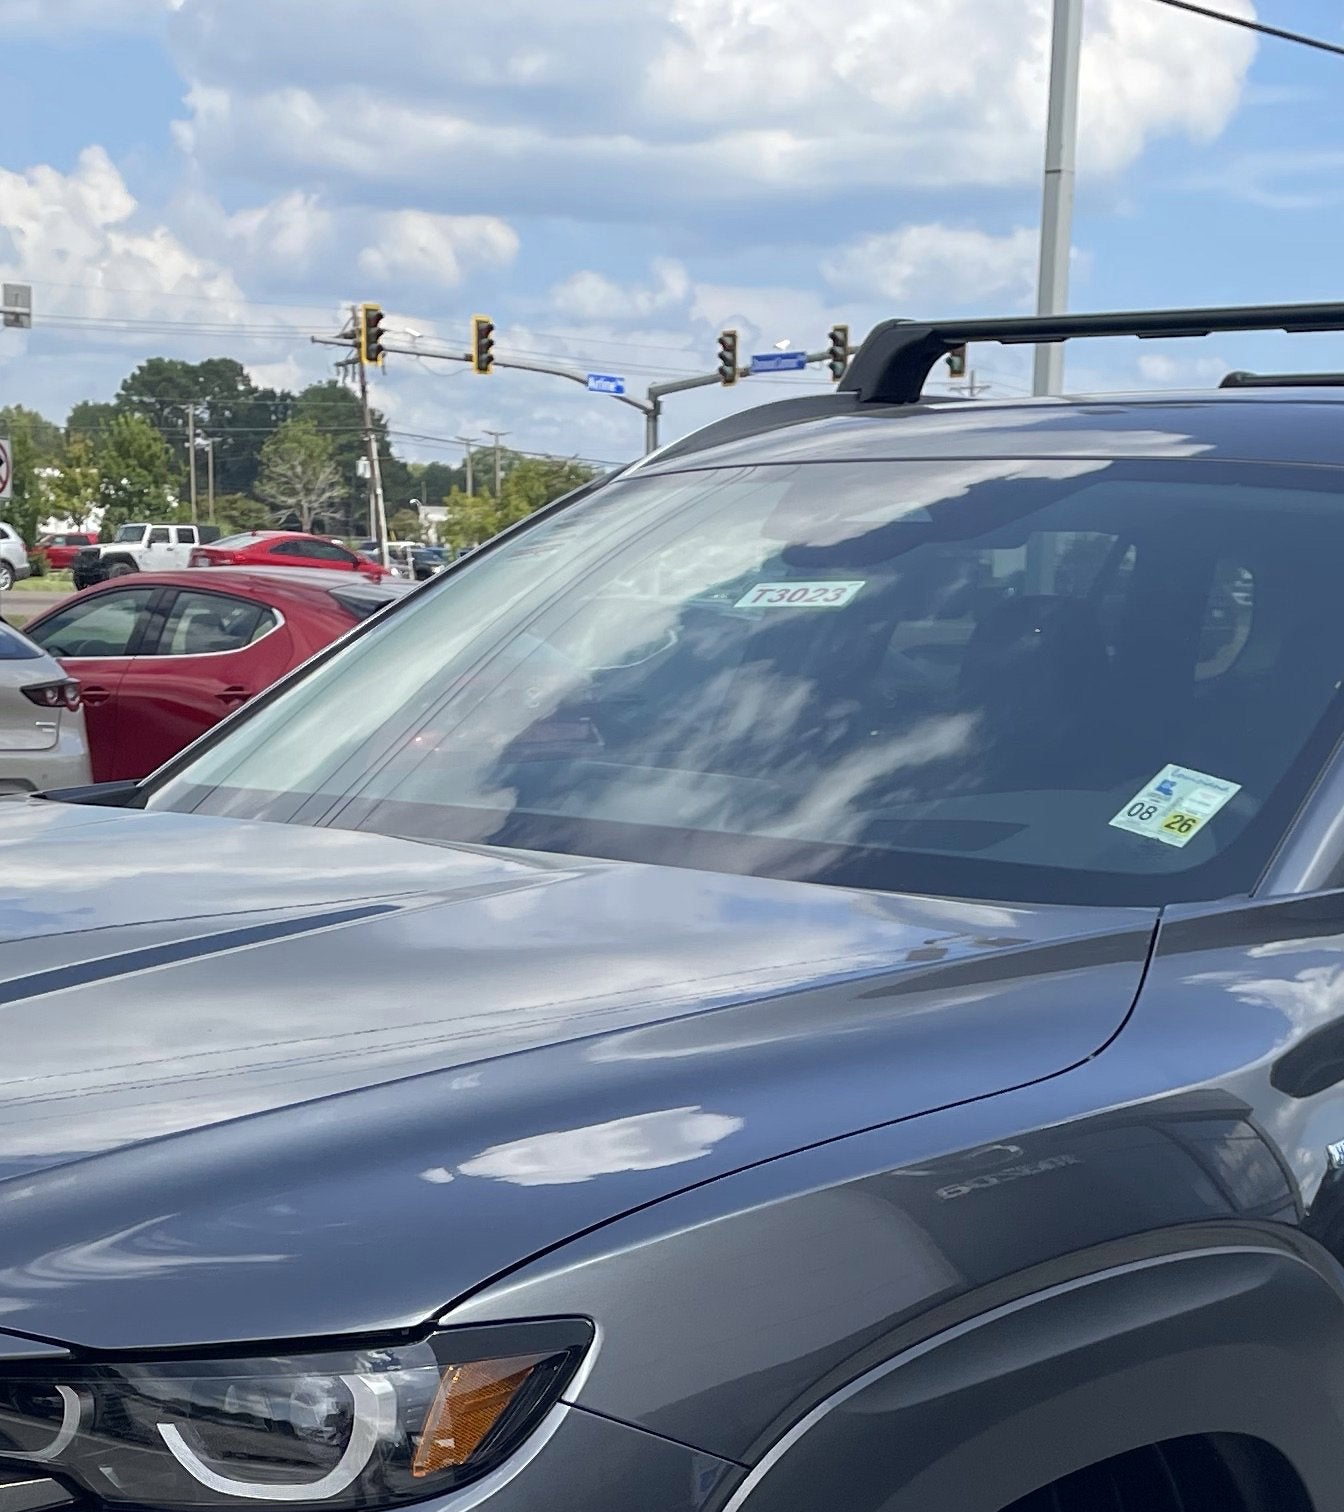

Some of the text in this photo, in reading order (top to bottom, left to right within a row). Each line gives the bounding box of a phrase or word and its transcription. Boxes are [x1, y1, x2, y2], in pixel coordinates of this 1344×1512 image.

[751, 587, 847, 603] T3023
[1127, 802, 1158, 821] 08
[1164, 814, 1197, 834] 26
